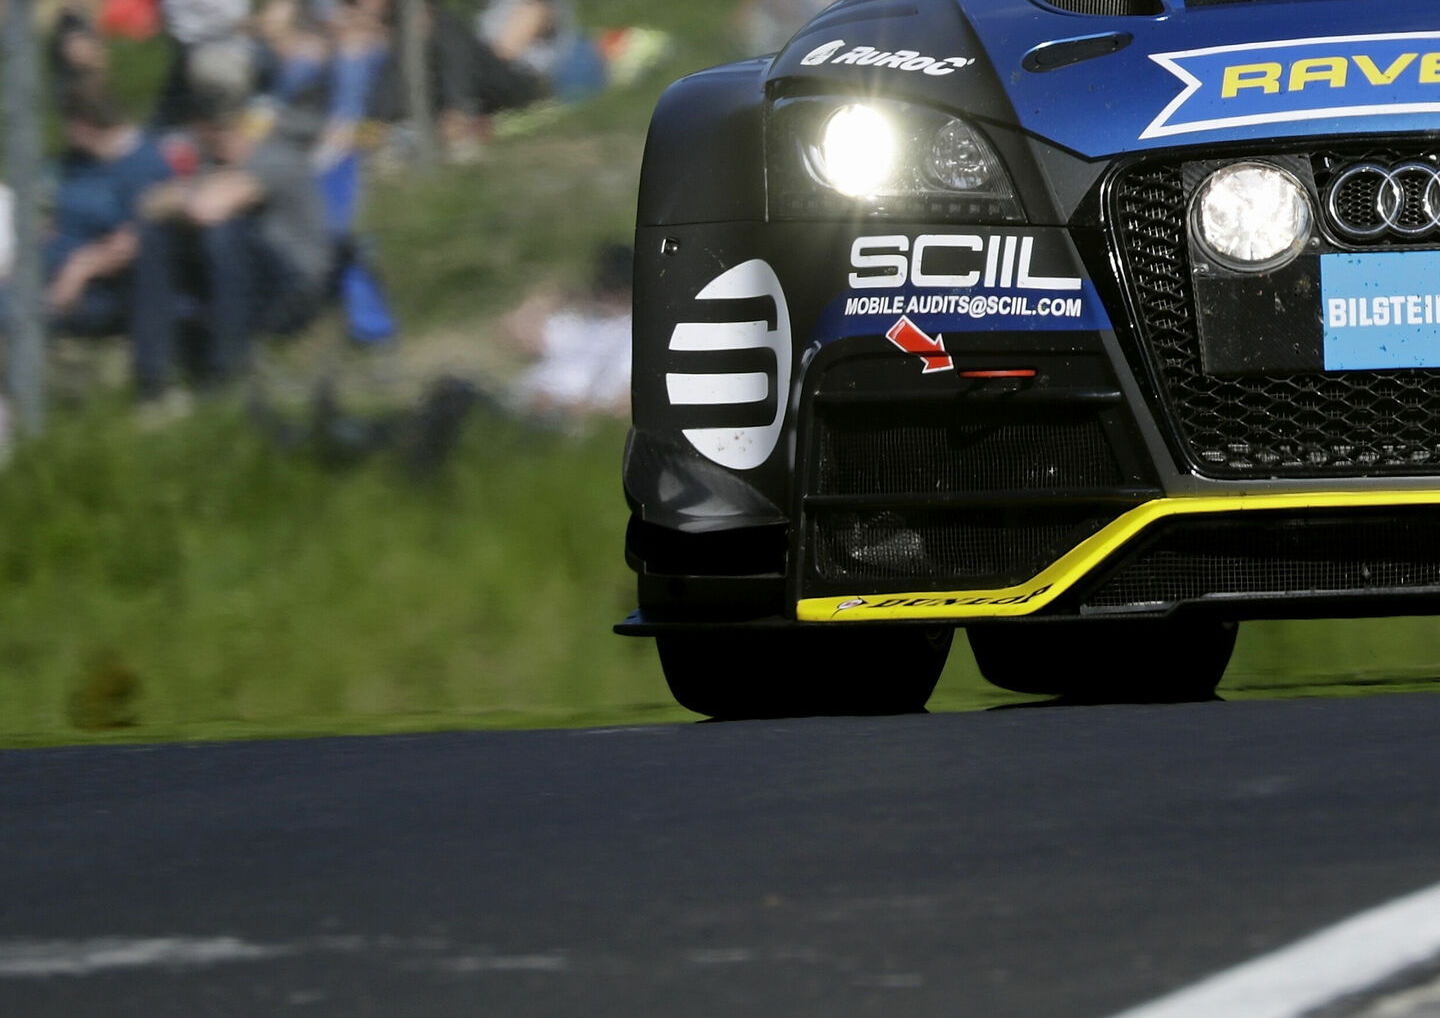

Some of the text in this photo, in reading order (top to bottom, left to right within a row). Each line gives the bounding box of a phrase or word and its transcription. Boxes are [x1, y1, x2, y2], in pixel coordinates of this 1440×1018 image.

[848, 234, 1082, 290] SCIIL
[844, 296, 1082, 318] MOBILE AUDITS@SCIIL.COM
[866, 583, 1054, 608] DUNLOP
